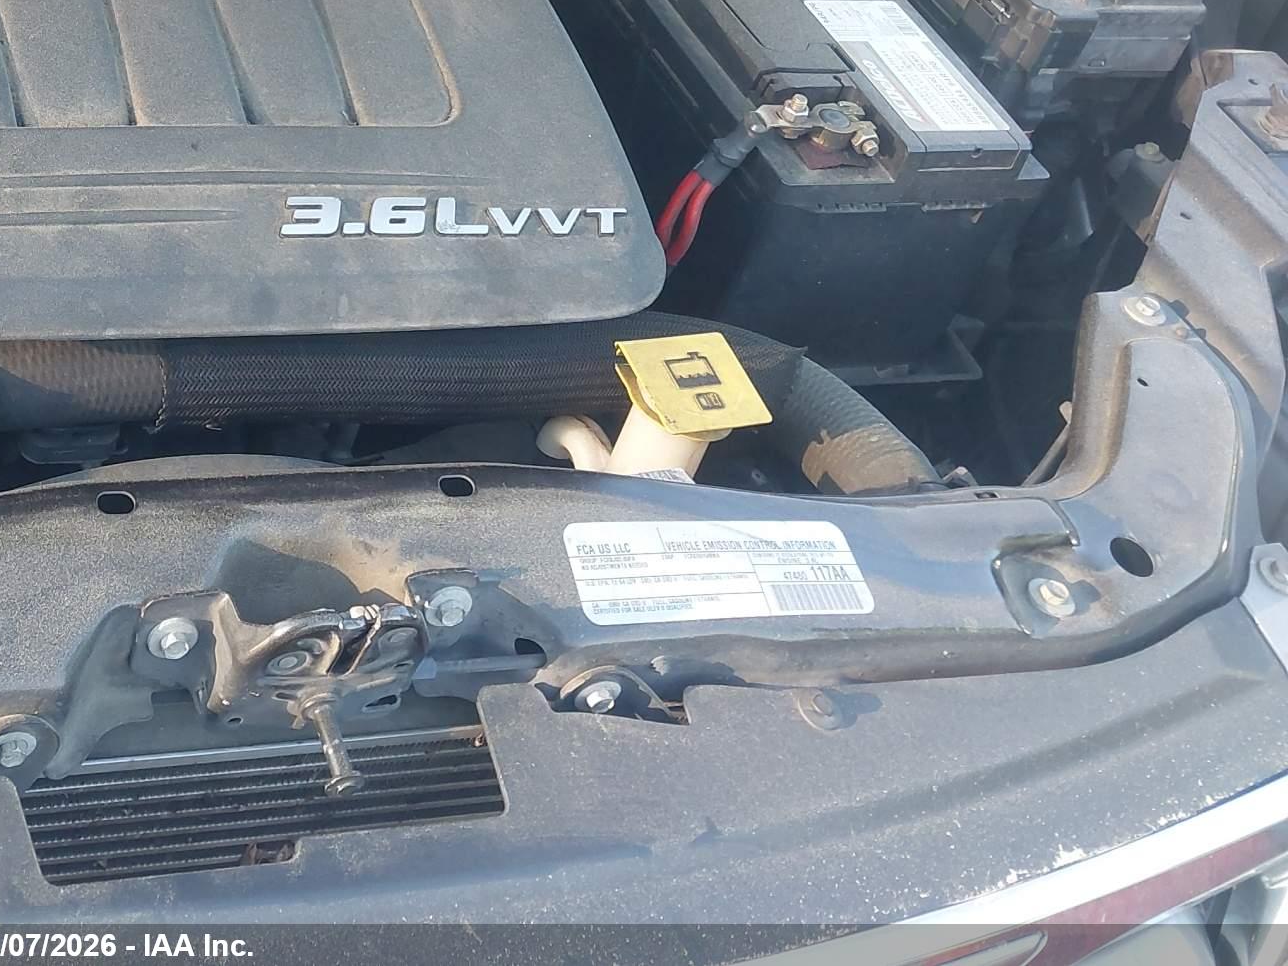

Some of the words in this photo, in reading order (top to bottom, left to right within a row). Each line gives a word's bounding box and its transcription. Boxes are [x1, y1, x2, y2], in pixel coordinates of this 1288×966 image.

[576, 544, 594, 555] FCA
[597, 543, 611, 554] US
[614, 542, 631, 553] LLC
[665, 541, 702, 552] VEHICLE
[702, 540, 742, 551] EMISSION
[743, 540, 779, 551] CONTROL
[781, 540, 837, 551] INFORMATION
[810, 566, 851, 581] 117AA
